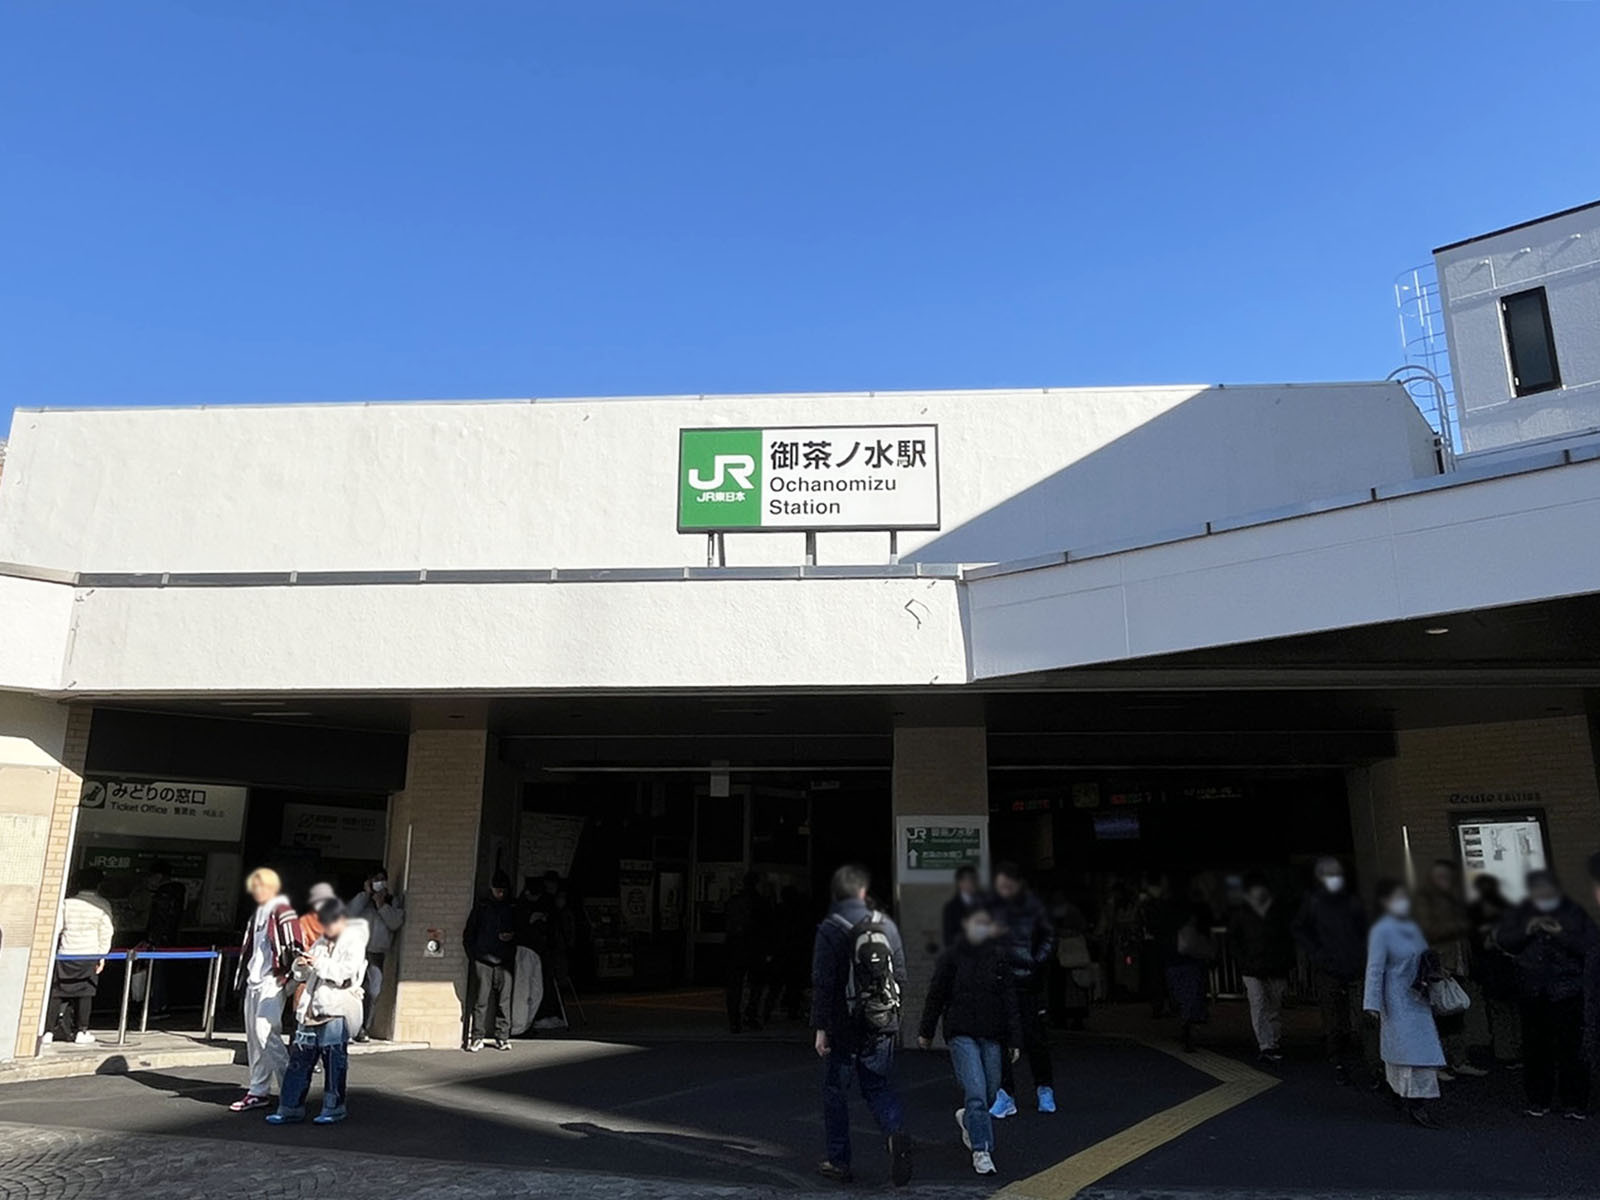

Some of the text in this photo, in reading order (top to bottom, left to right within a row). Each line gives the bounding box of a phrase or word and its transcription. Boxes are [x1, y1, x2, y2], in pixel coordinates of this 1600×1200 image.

[770, 440, 927, 470] 御茶ノ水駅
[688, 454, 755, 490] JR
[770, 476, 896, 492] Ochanomizu
[769, 500, 841, 515] Station
[112, 784, 206, 805] みどりの窓口
[111, 801, 139, 812] Ticket
[140, 803, 168, 815] Office
